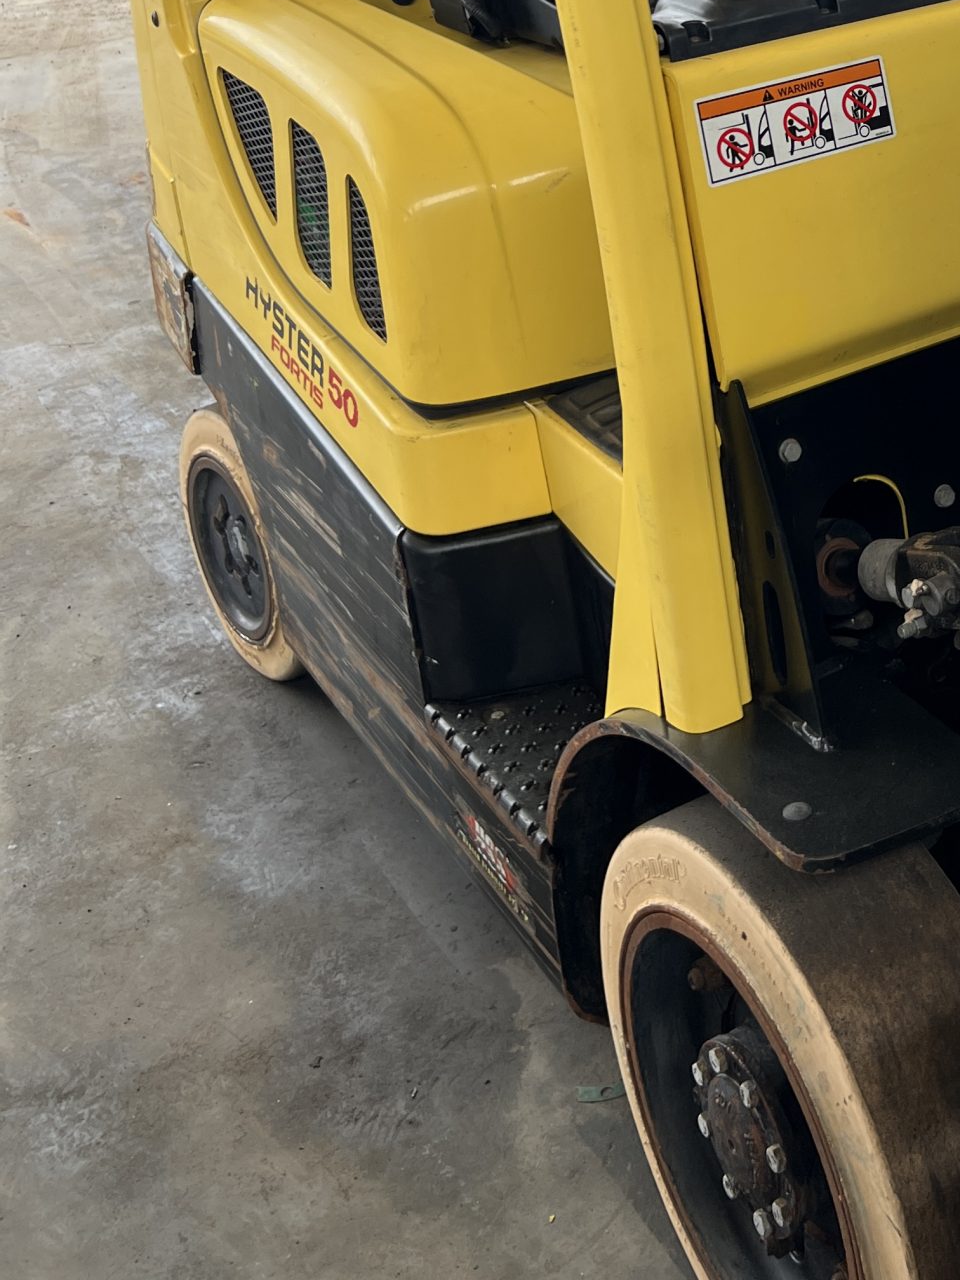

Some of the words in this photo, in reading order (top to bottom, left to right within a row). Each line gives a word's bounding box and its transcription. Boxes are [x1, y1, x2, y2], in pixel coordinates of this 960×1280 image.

[777, 78, 825, 97] WARNING
[245, 276, 324, 388] HYSTER
[327, 365, 360, 428] 50
[271, 334, 324, 410] FORTIS
